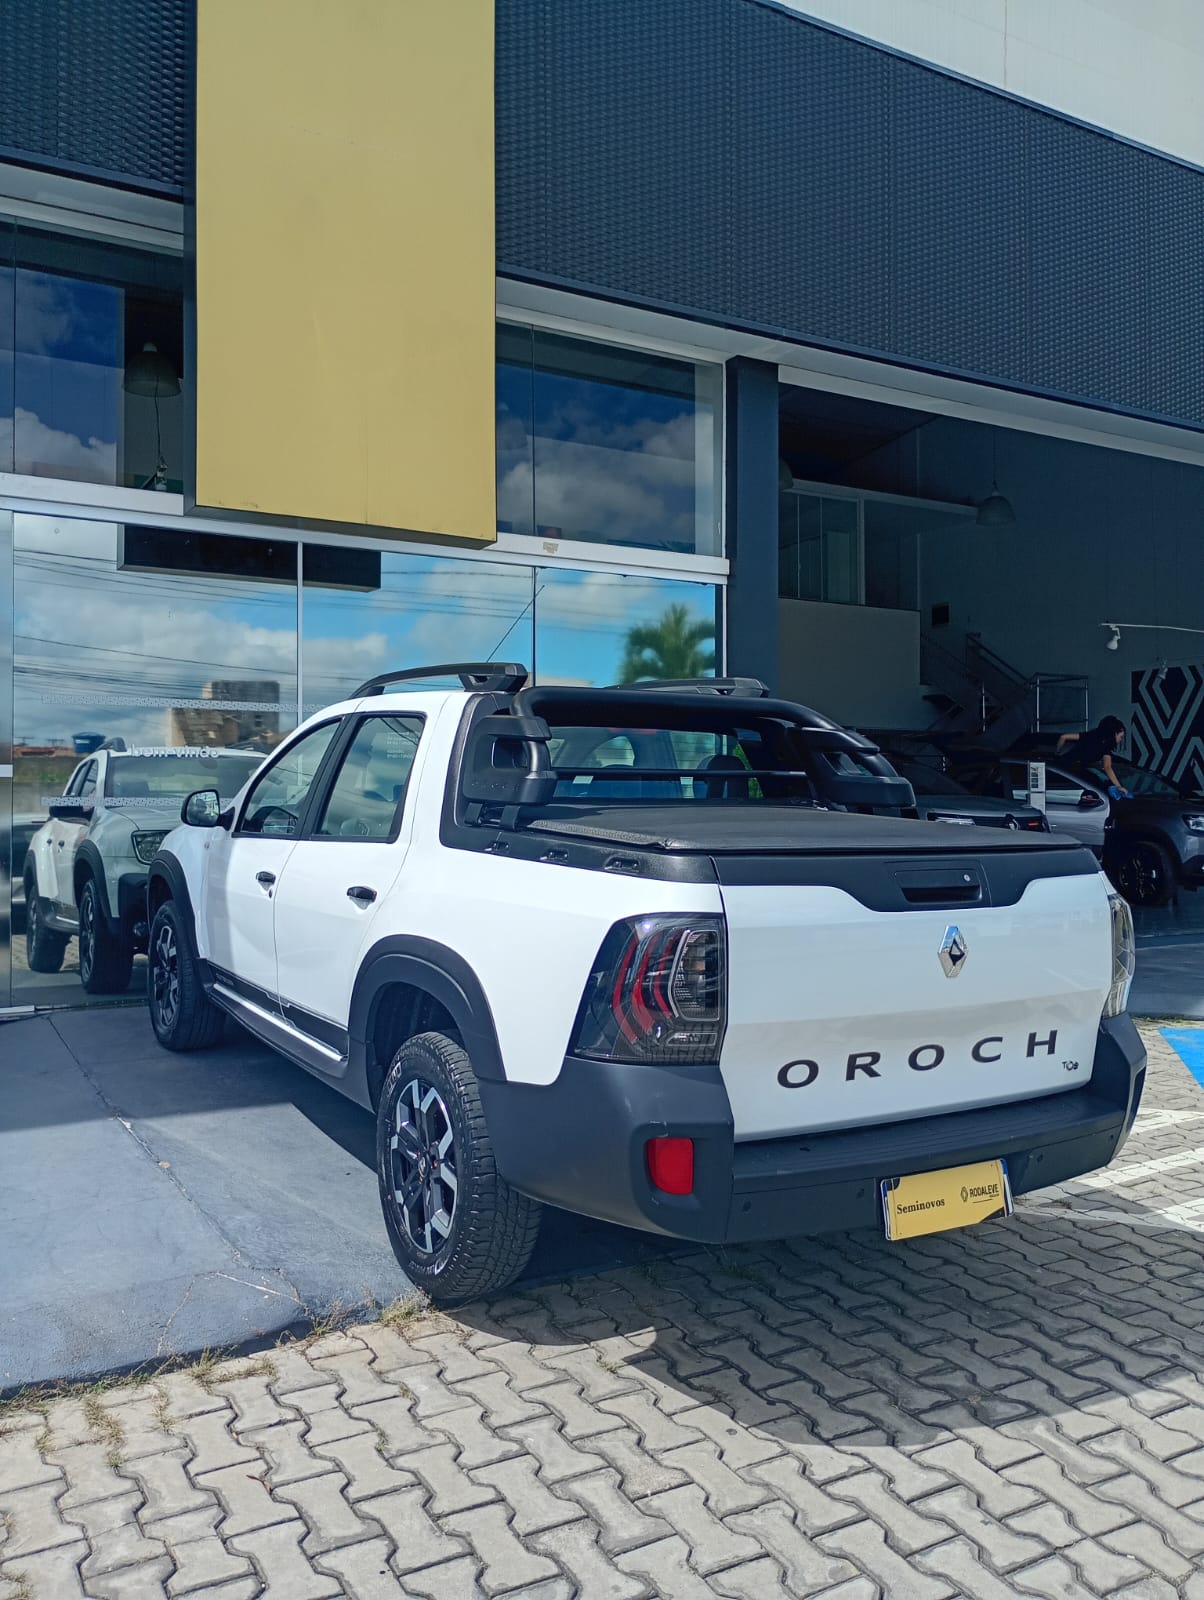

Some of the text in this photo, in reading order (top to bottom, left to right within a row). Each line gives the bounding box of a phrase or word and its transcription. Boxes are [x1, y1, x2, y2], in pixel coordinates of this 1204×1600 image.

[776, 1029, 1058, 1089] OROCH
[969, 1183, 1000, 1198] RODALEVE
[896, 1198, 946, 1215] Seminovos
